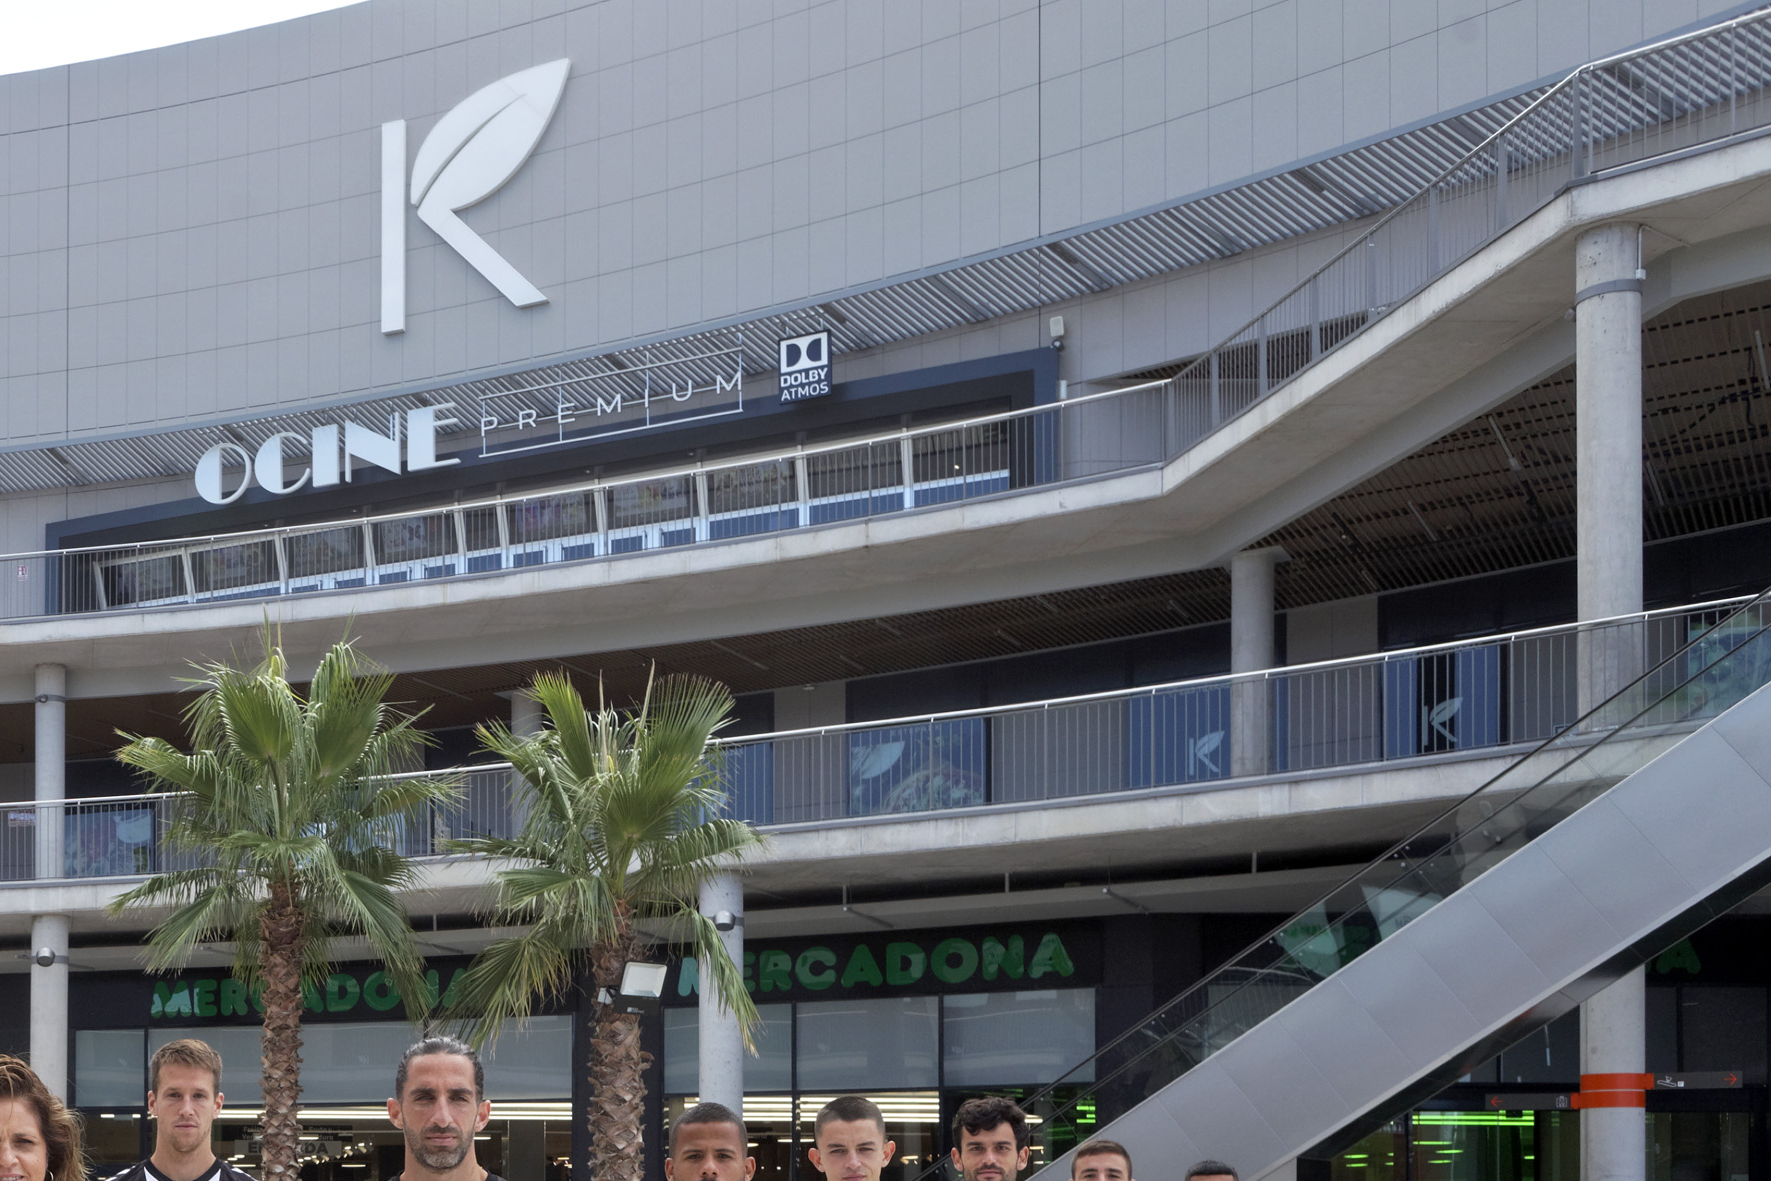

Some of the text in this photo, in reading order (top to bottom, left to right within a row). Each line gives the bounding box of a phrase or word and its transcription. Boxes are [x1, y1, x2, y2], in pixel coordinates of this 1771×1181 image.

[780, 367, 828, 388] DOLBY
[781, 381, 829, 402] ATMOS
[194, 372, 743, 505] OCINE PREMIUM
